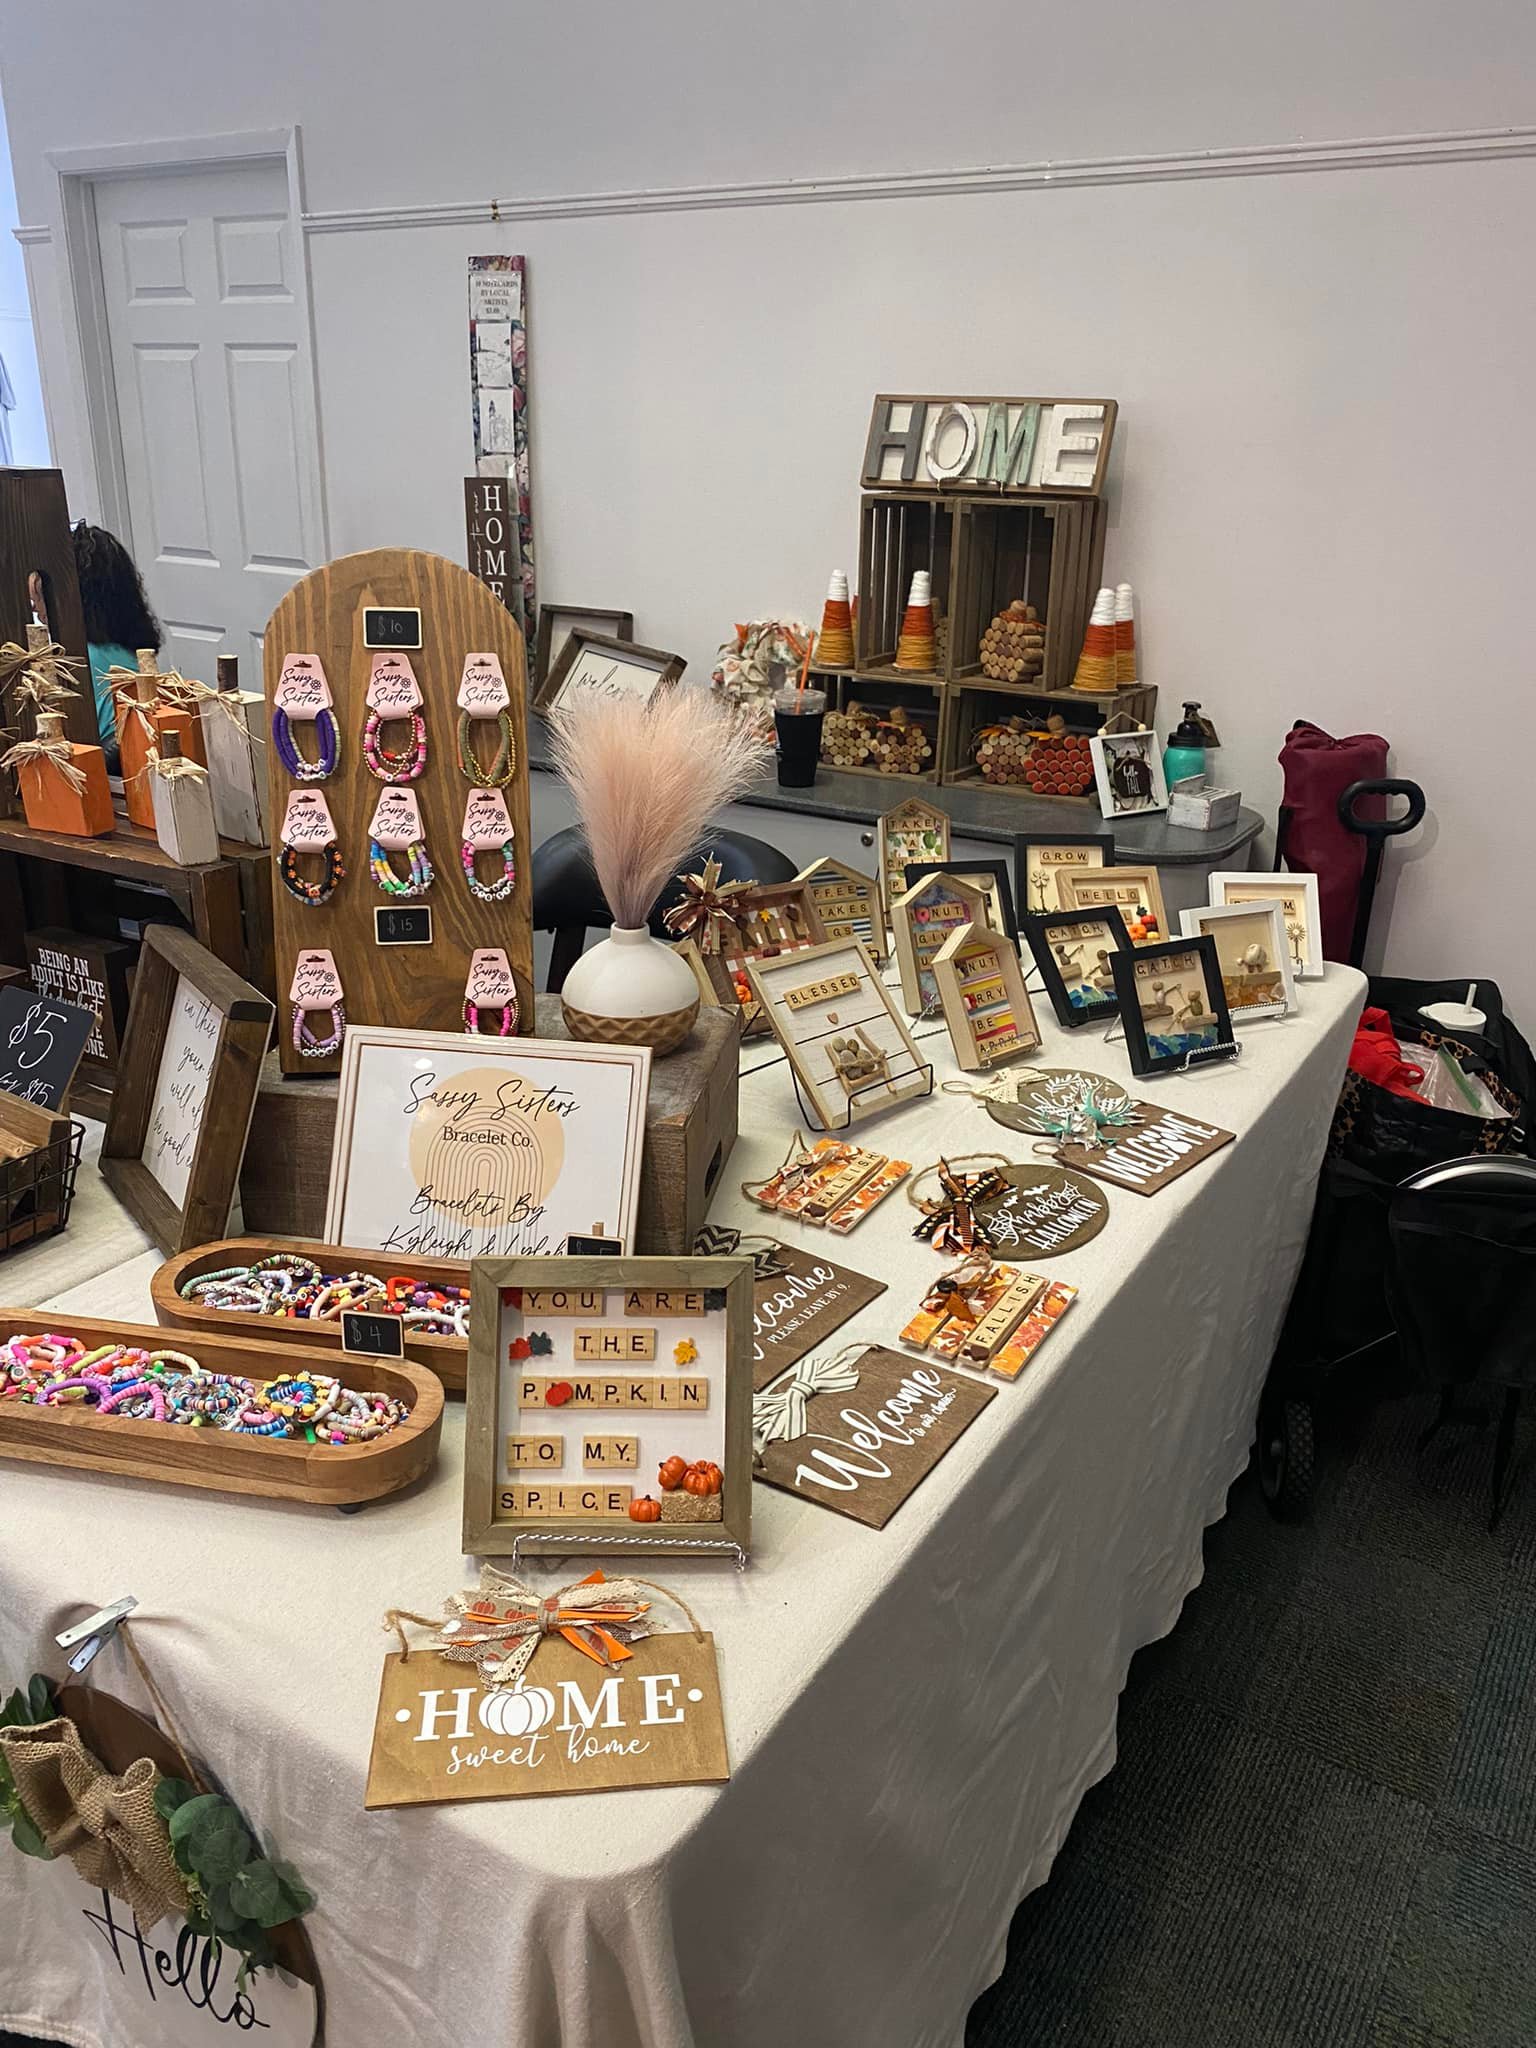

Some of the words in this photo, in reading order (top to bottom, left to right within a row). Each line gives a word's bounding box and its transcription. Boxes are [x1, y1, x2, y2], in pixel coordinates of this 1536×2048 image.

[866, 402, 1105, 488] HOME
[576, 664, 645, 700] welco
[282, 687, 324, 706] Sisters
[374, 687, 415, 708] Sisters
[465, 686, 504, 707] Sisters
[288, 823, 332, 842] Sisters
[375, 820, 417, 840] Sisters
[468, 820, 510, 840] Sisters
[890, 818, 931, 829] TAKE
[1042, 852, 1087, 860] GROW
[813, 885, 856, 898] FFEE
[1082, 890, 1138, 900] HELLO
[919, 932, 948, 944] GIV
[1049, 925, 1103, 938] CATCH
[38, 947, 71, 972] BEING
[73, 956, 90, 977] AN
[968, 957, 994, 972] NUT
[1137, 955, 1195, 976] CATCH
[30, 963, 64, 988] ADULT
[65, 972, 78, 992] IS
[79, 976, 106, 1000] LIKE
[296, 982, 339, 1002] Sisters
[472, 980, 512, 1000] Sisters
[790, 976, 858, 1004] BLESSED
[976, 988, 1004, 1003] RRY
[977, 1018, 994, 1030] BE
[8, 1001, 68, 1069] $5
[980, 1034, 1017, 1053] APPY
[403, 1072, 483, 1121] Sassy
[490, 1079, 581, 1121] Sisters
[442, 1126, 508, 1147] Bracelet
[511, 1131, 534, 1148] Co.
[1087, 1113, 1220, 1185] WELCOME
[817, 1151, 880, 1204] FALLISH
[409, 1184, 505, 1217] Bracelets
[508, 1193, 548, 1228] By
[1024, 1197, 1103, 1250] HALLOWEEN
[379, 1224, 473, 1258] Kyleigh
[527, 1291, 597, 1311] YOU
[628, 1291, 700, 1312] ARE
[975, 1275, 1040, 1344] FALLISH
[753, 1266, 835, 1360] come
[766, 1317, 805, 1345] PLEASE
[798, 1297, 831, 1320] LEAVE
[824, 1288, 841, 1300] BY
[579, 1335, 648, 1354] THE
[523, 1382, 700, 1403] PMPKIN
[794, 1369, 943, 1493] Welcome
[512, 1443, 556, 1462] TO
[586, 1443, 630, 1462] MY
[501, 1492, 625, 1511] SPICE
[446, 1733, 549, 1775] sweet
[567, 1722, 650, 1764] home
[82, 1887, 271, 2030] Hello
